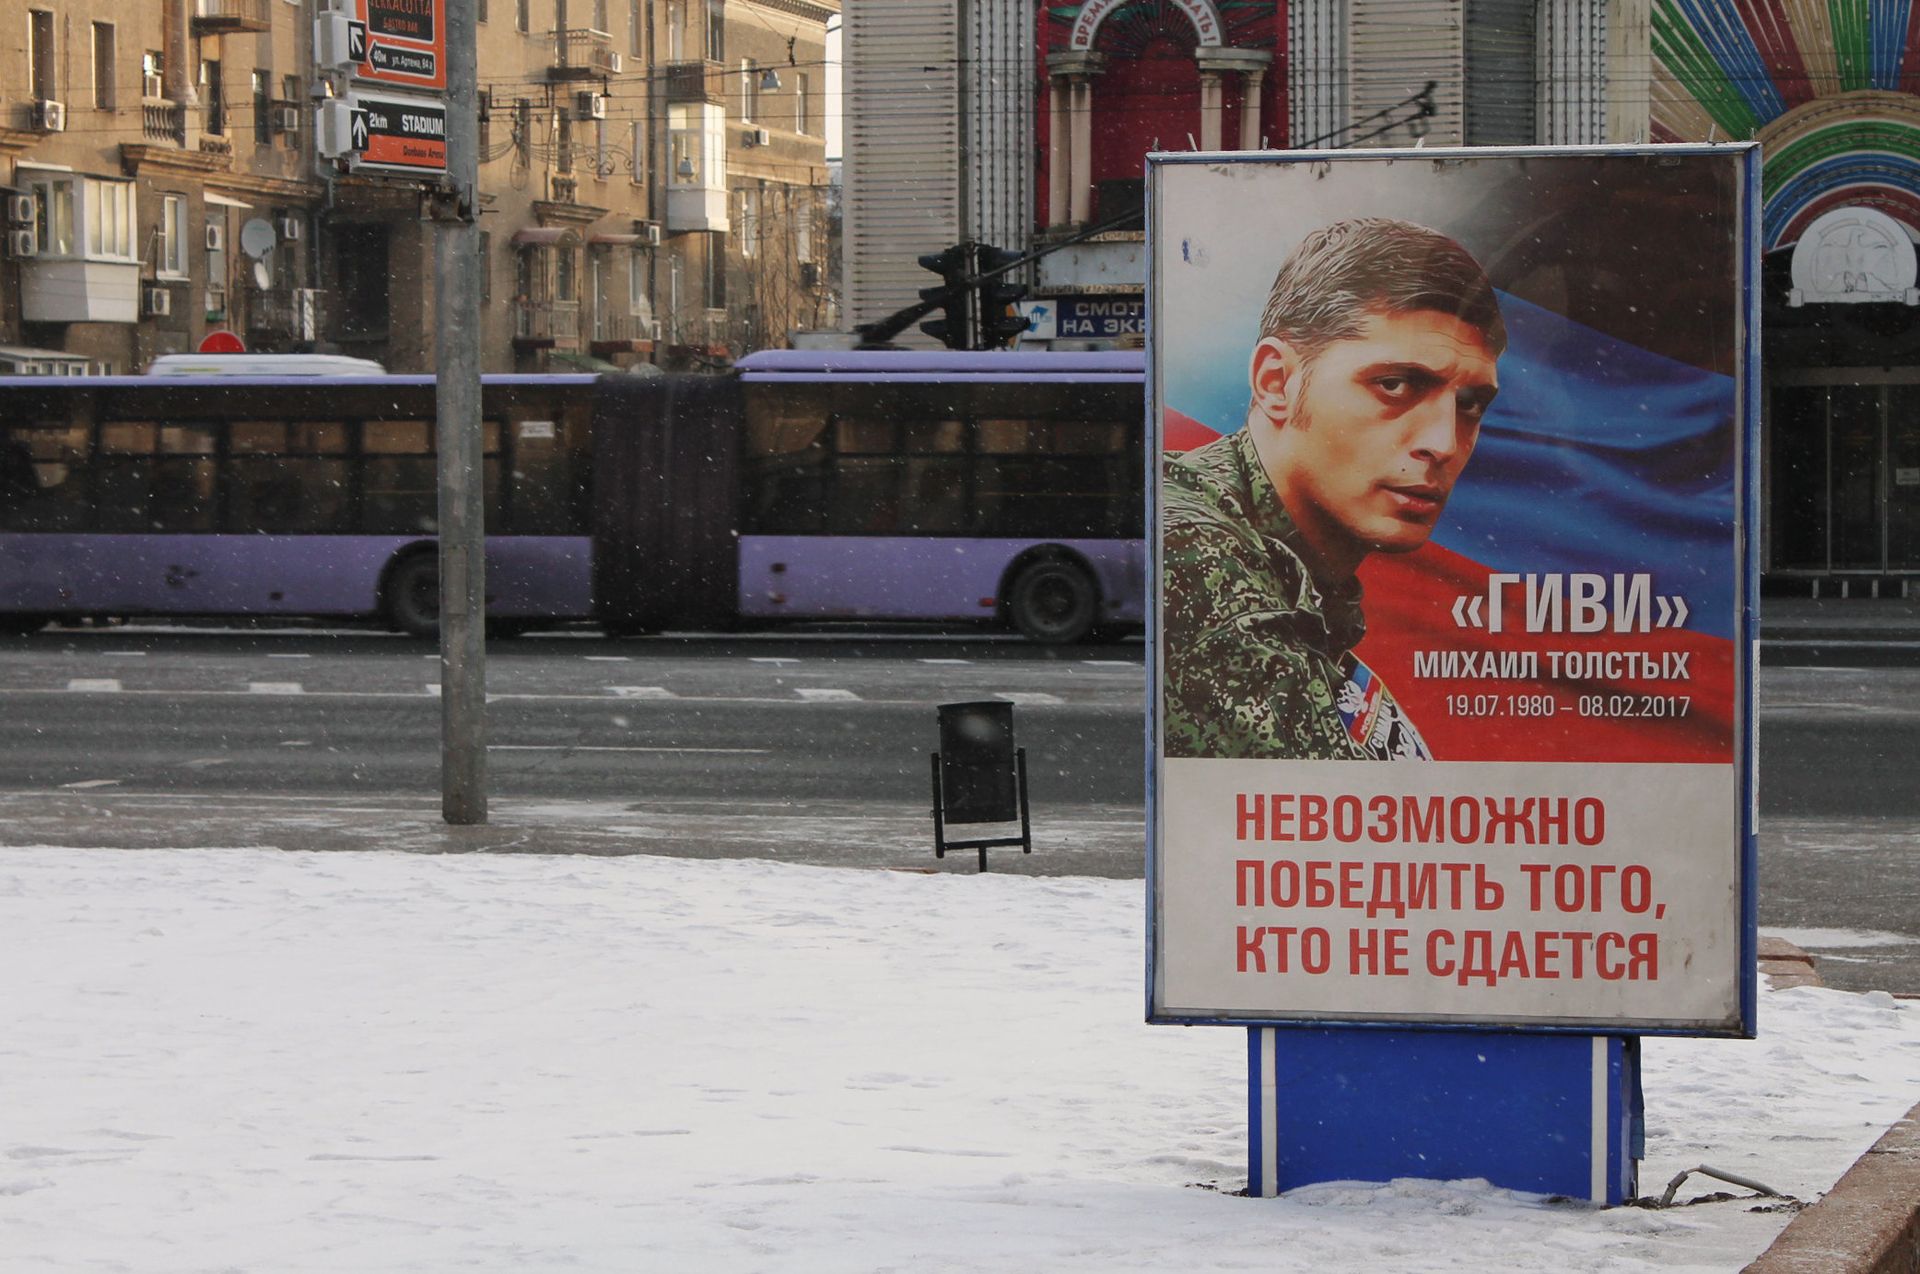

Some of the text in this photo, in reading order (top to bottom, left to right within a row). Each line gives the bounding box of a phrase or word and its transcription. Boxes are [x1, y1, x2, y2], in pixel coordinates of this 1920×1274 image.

[369, 112, 444, 135] 2km STADIUM
[1062, 320, 1095, 334] НА
[1451, 573, 1689, 633] «ГИВИ»
[1413, 651, 1690, 680] МИХАИЛ ТОЛСТЫХ
[1446, 695, 1555, 716] 19.07.1980
[1579, 695, 1690, 717] 08.02.2017
[1236, 794, 1605, 846] НЕВОЗМОЖНО
[1236, 860, 1666, 919] ПОБЕДИТЬ ТОГО,
[1236, 926, 1658, 987] КТО НЕ СДАЕТСЯ
